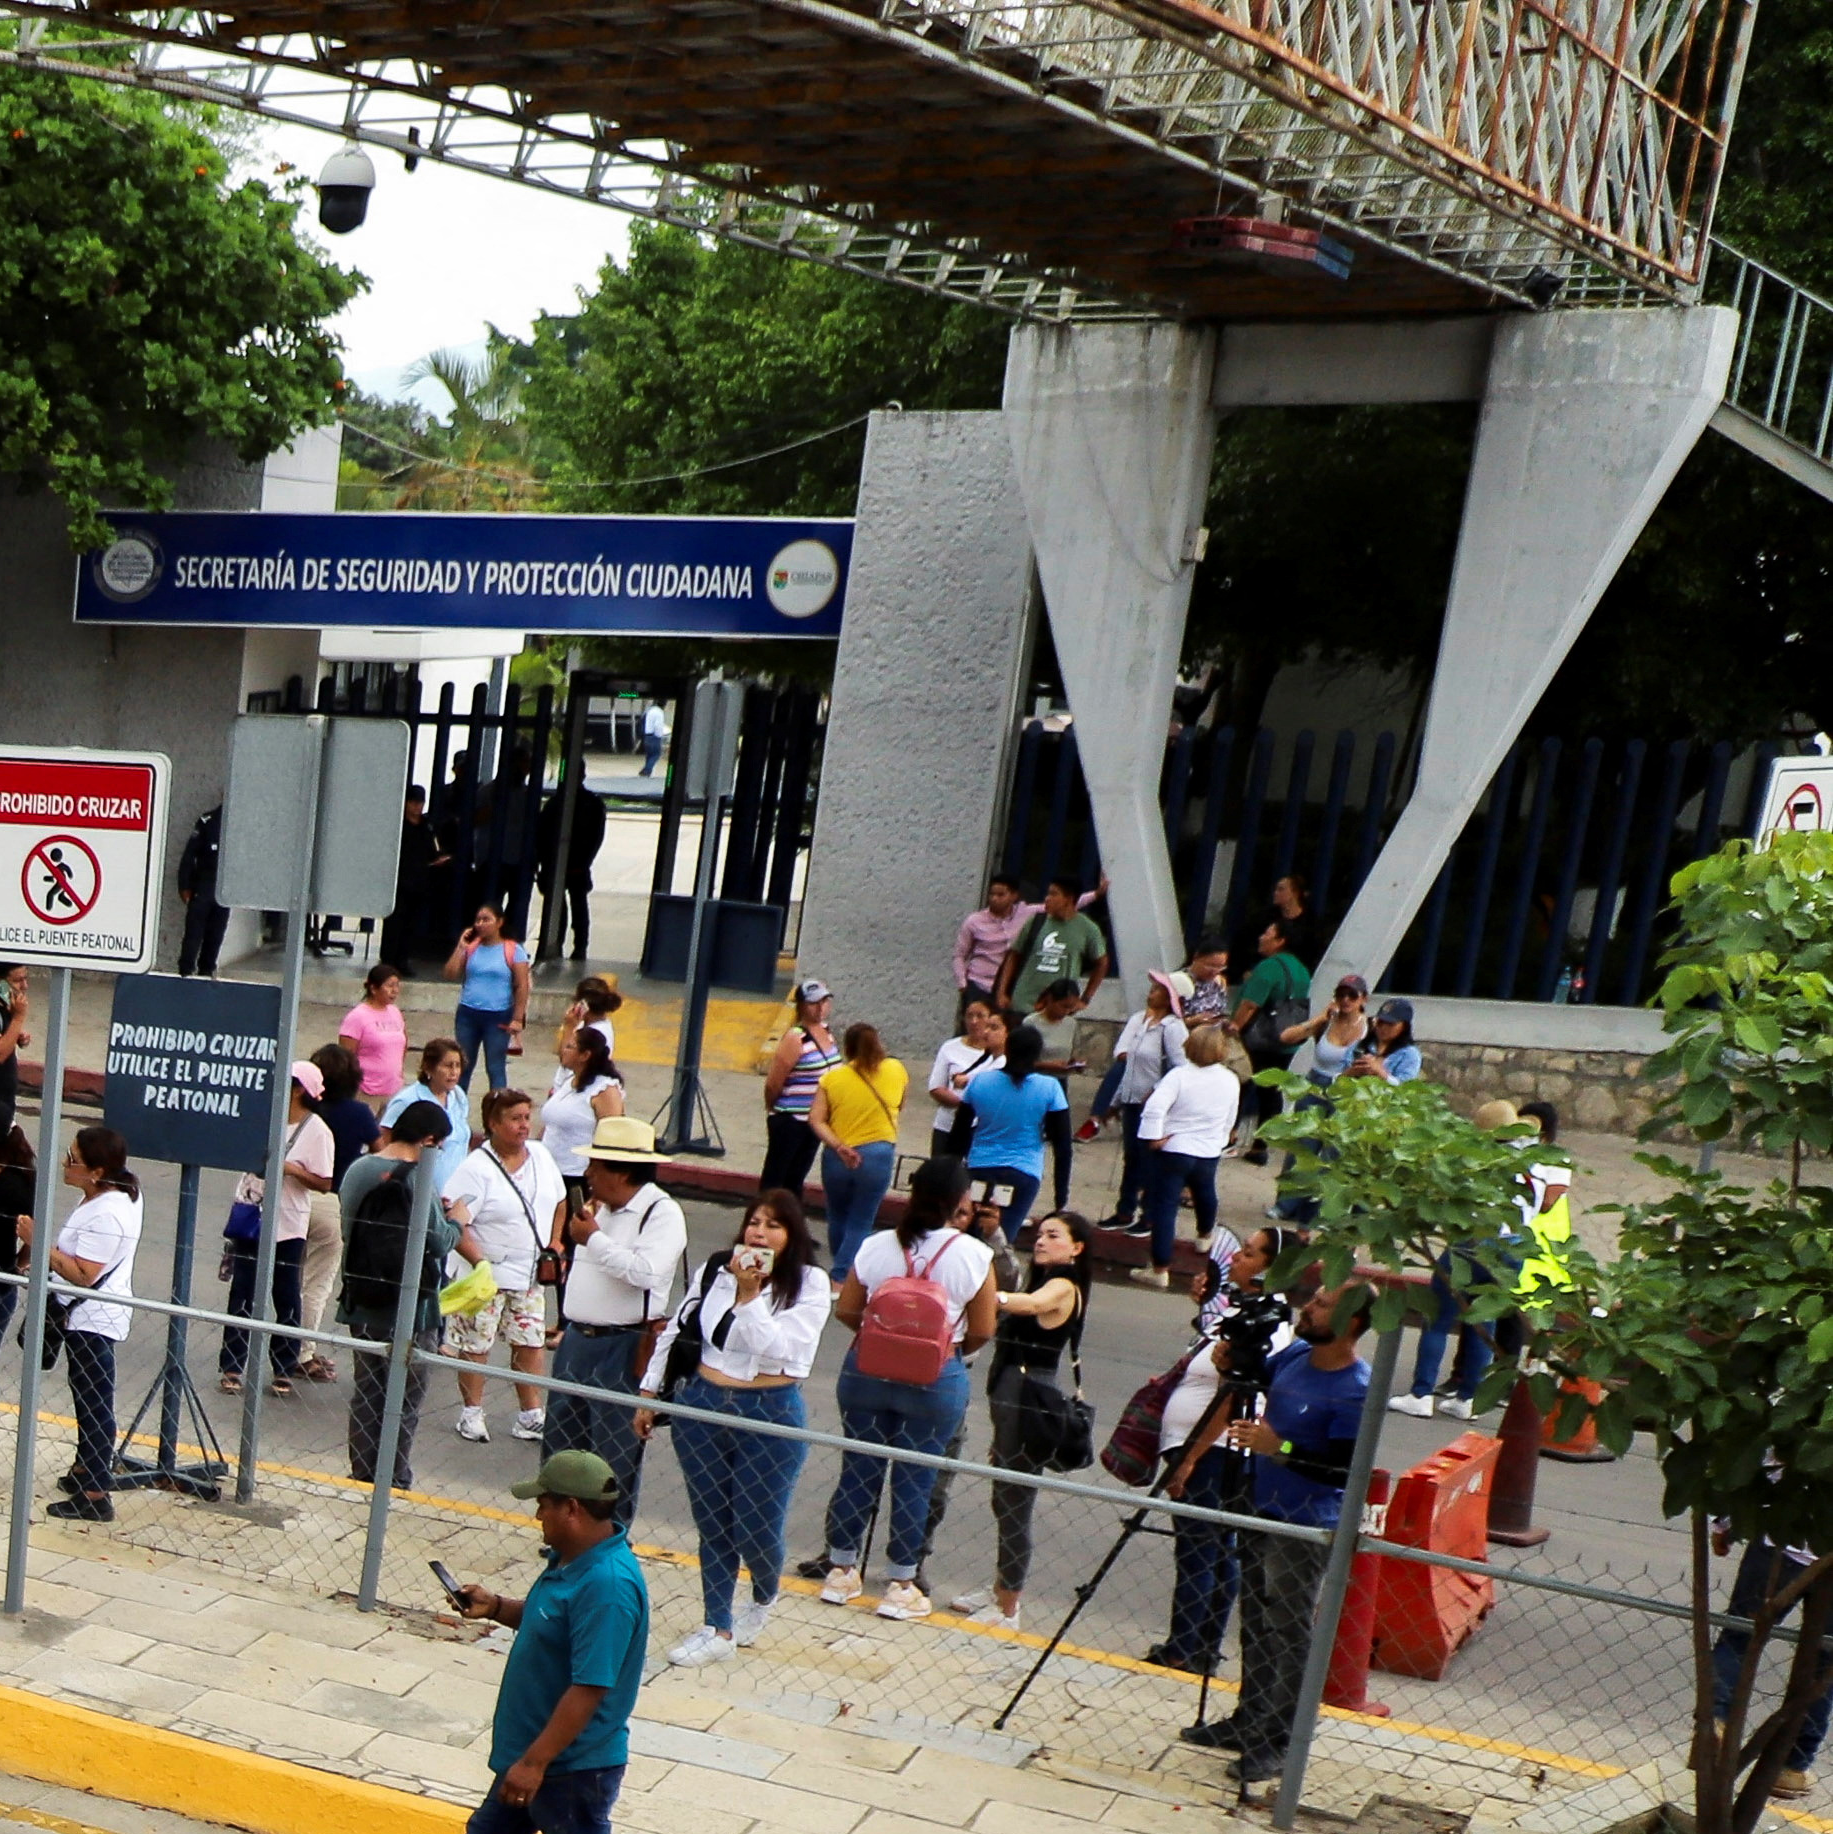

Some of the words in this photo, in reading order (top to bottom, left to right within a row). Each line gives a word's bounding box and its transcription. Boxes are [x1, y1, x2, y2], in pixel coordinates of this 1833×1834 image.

[174, 549, 296, 592] SECRETARÍA
[302, 557, 329, 592] DE
[334, 558, 462, 595] SEGURIDAD
[466, 560, 482, 594] Y
[484, 552, 621, 598] PROTECCIÓN
[626, 562, 753, 600] CIUDADANA
[77, 795, 142, 820] CRUZAR
[23, 927, 36, 944] EL
[39, 929, 80, 948] PUENTE
[82, 931, 136, 952] PEATONAL
[110, 1022, 206, 1055] PROHIBIDO
[209, 1033, 278, 1063] CRUZAR
[107, 1051, 170, 1080] UTILICE
[174, 1058, 192, 1082] EL
[197, 1062, 267, 1091] PUENTE
[143, 1084, 241, 1118] PEATONAL
